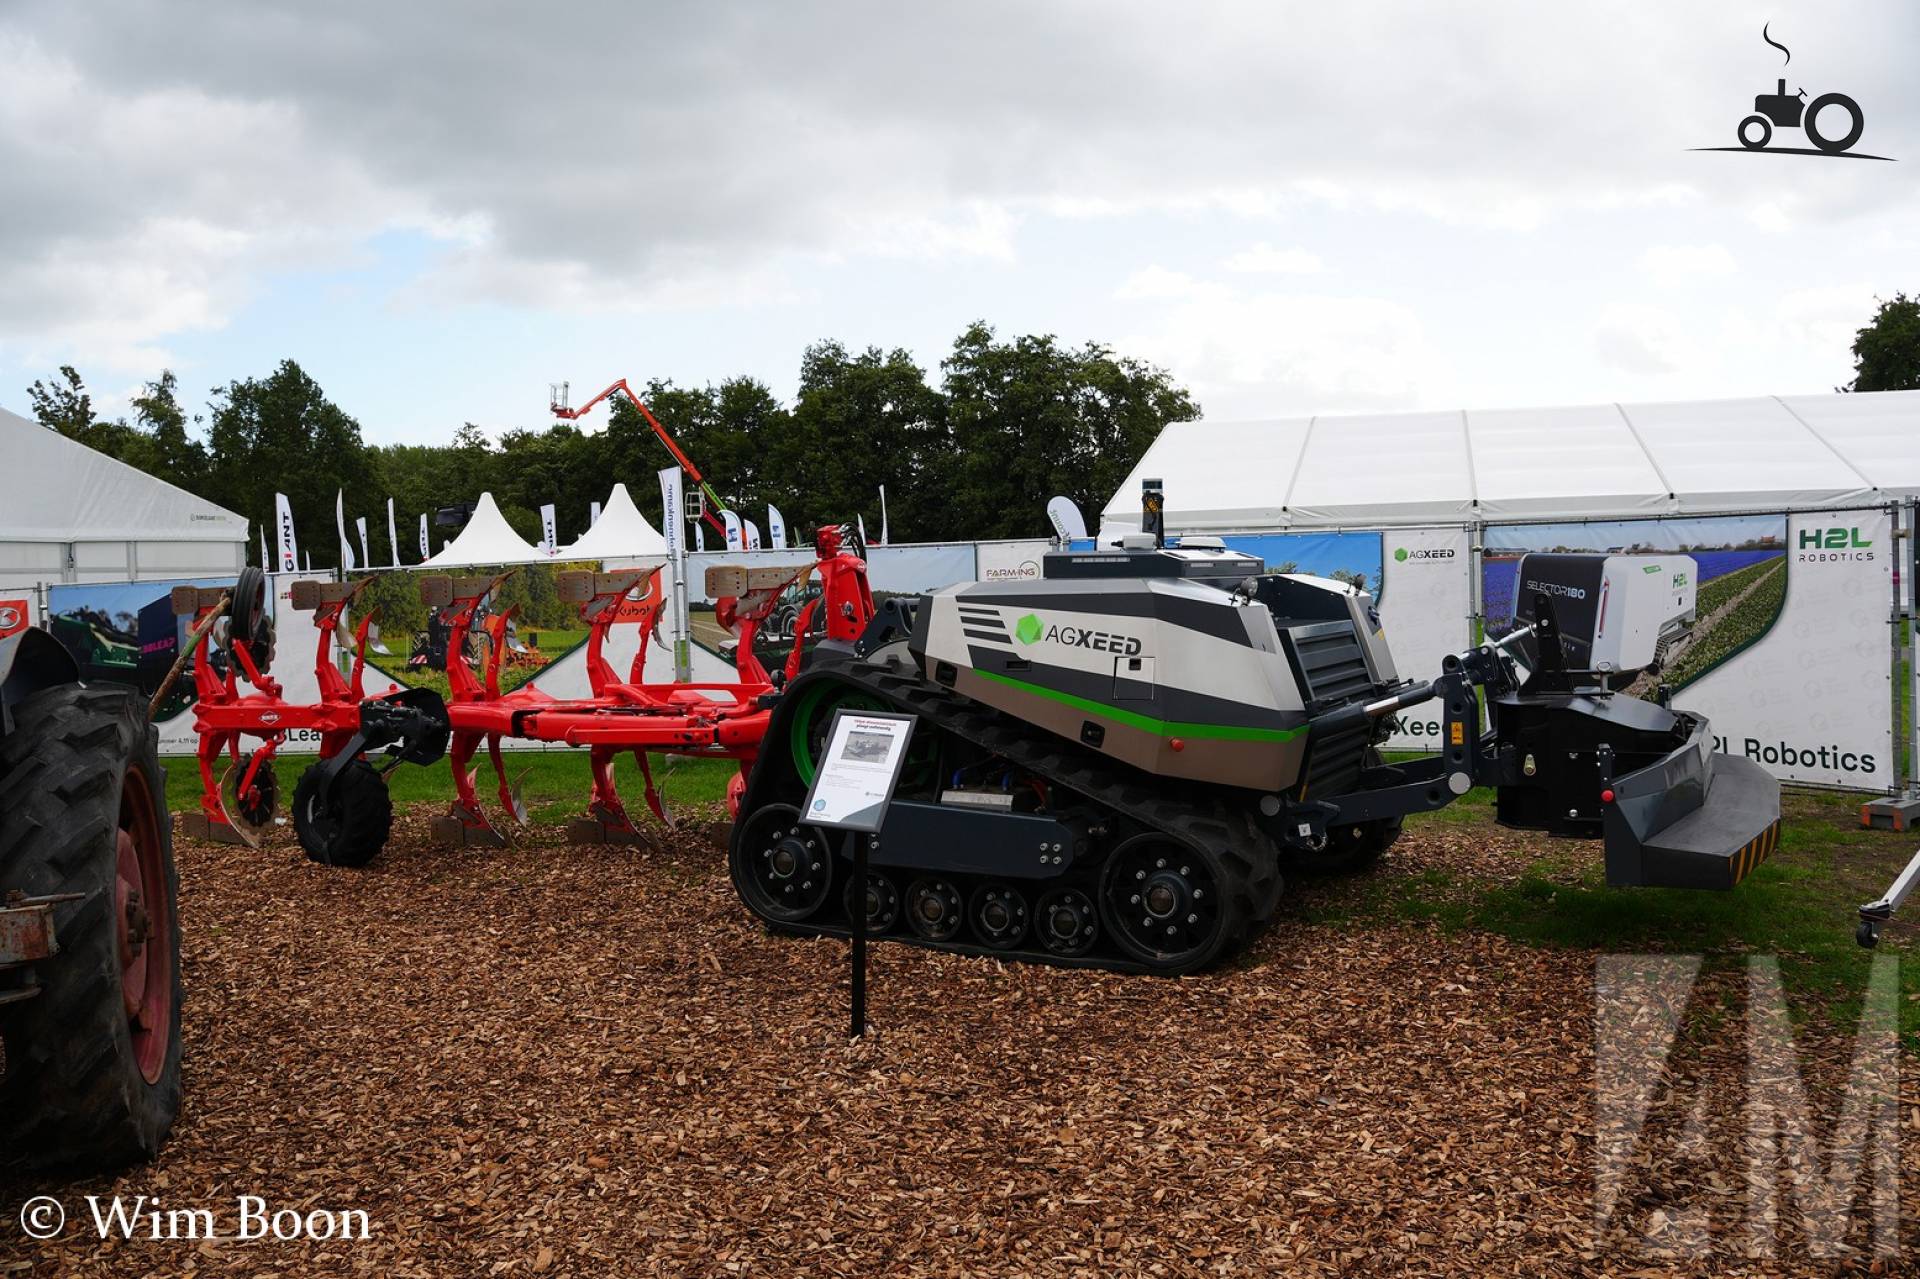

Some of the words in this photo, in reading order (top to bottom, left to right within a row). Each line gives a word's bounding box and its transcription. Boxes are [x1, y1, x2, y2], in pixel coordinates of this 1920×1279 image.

[282, 511, 295, 572] GIANT
[1799, 526, 1873, 550] H2L
[1409, 548, 1455, 559] AGXEED
[1799, 552, 1874, 563] ROBOTICS
[1044, 624, 1143, 656] AGXEED
[1393, 715, 1444, 737] Xee
[1745, 736, 1876, 774] Robotics
